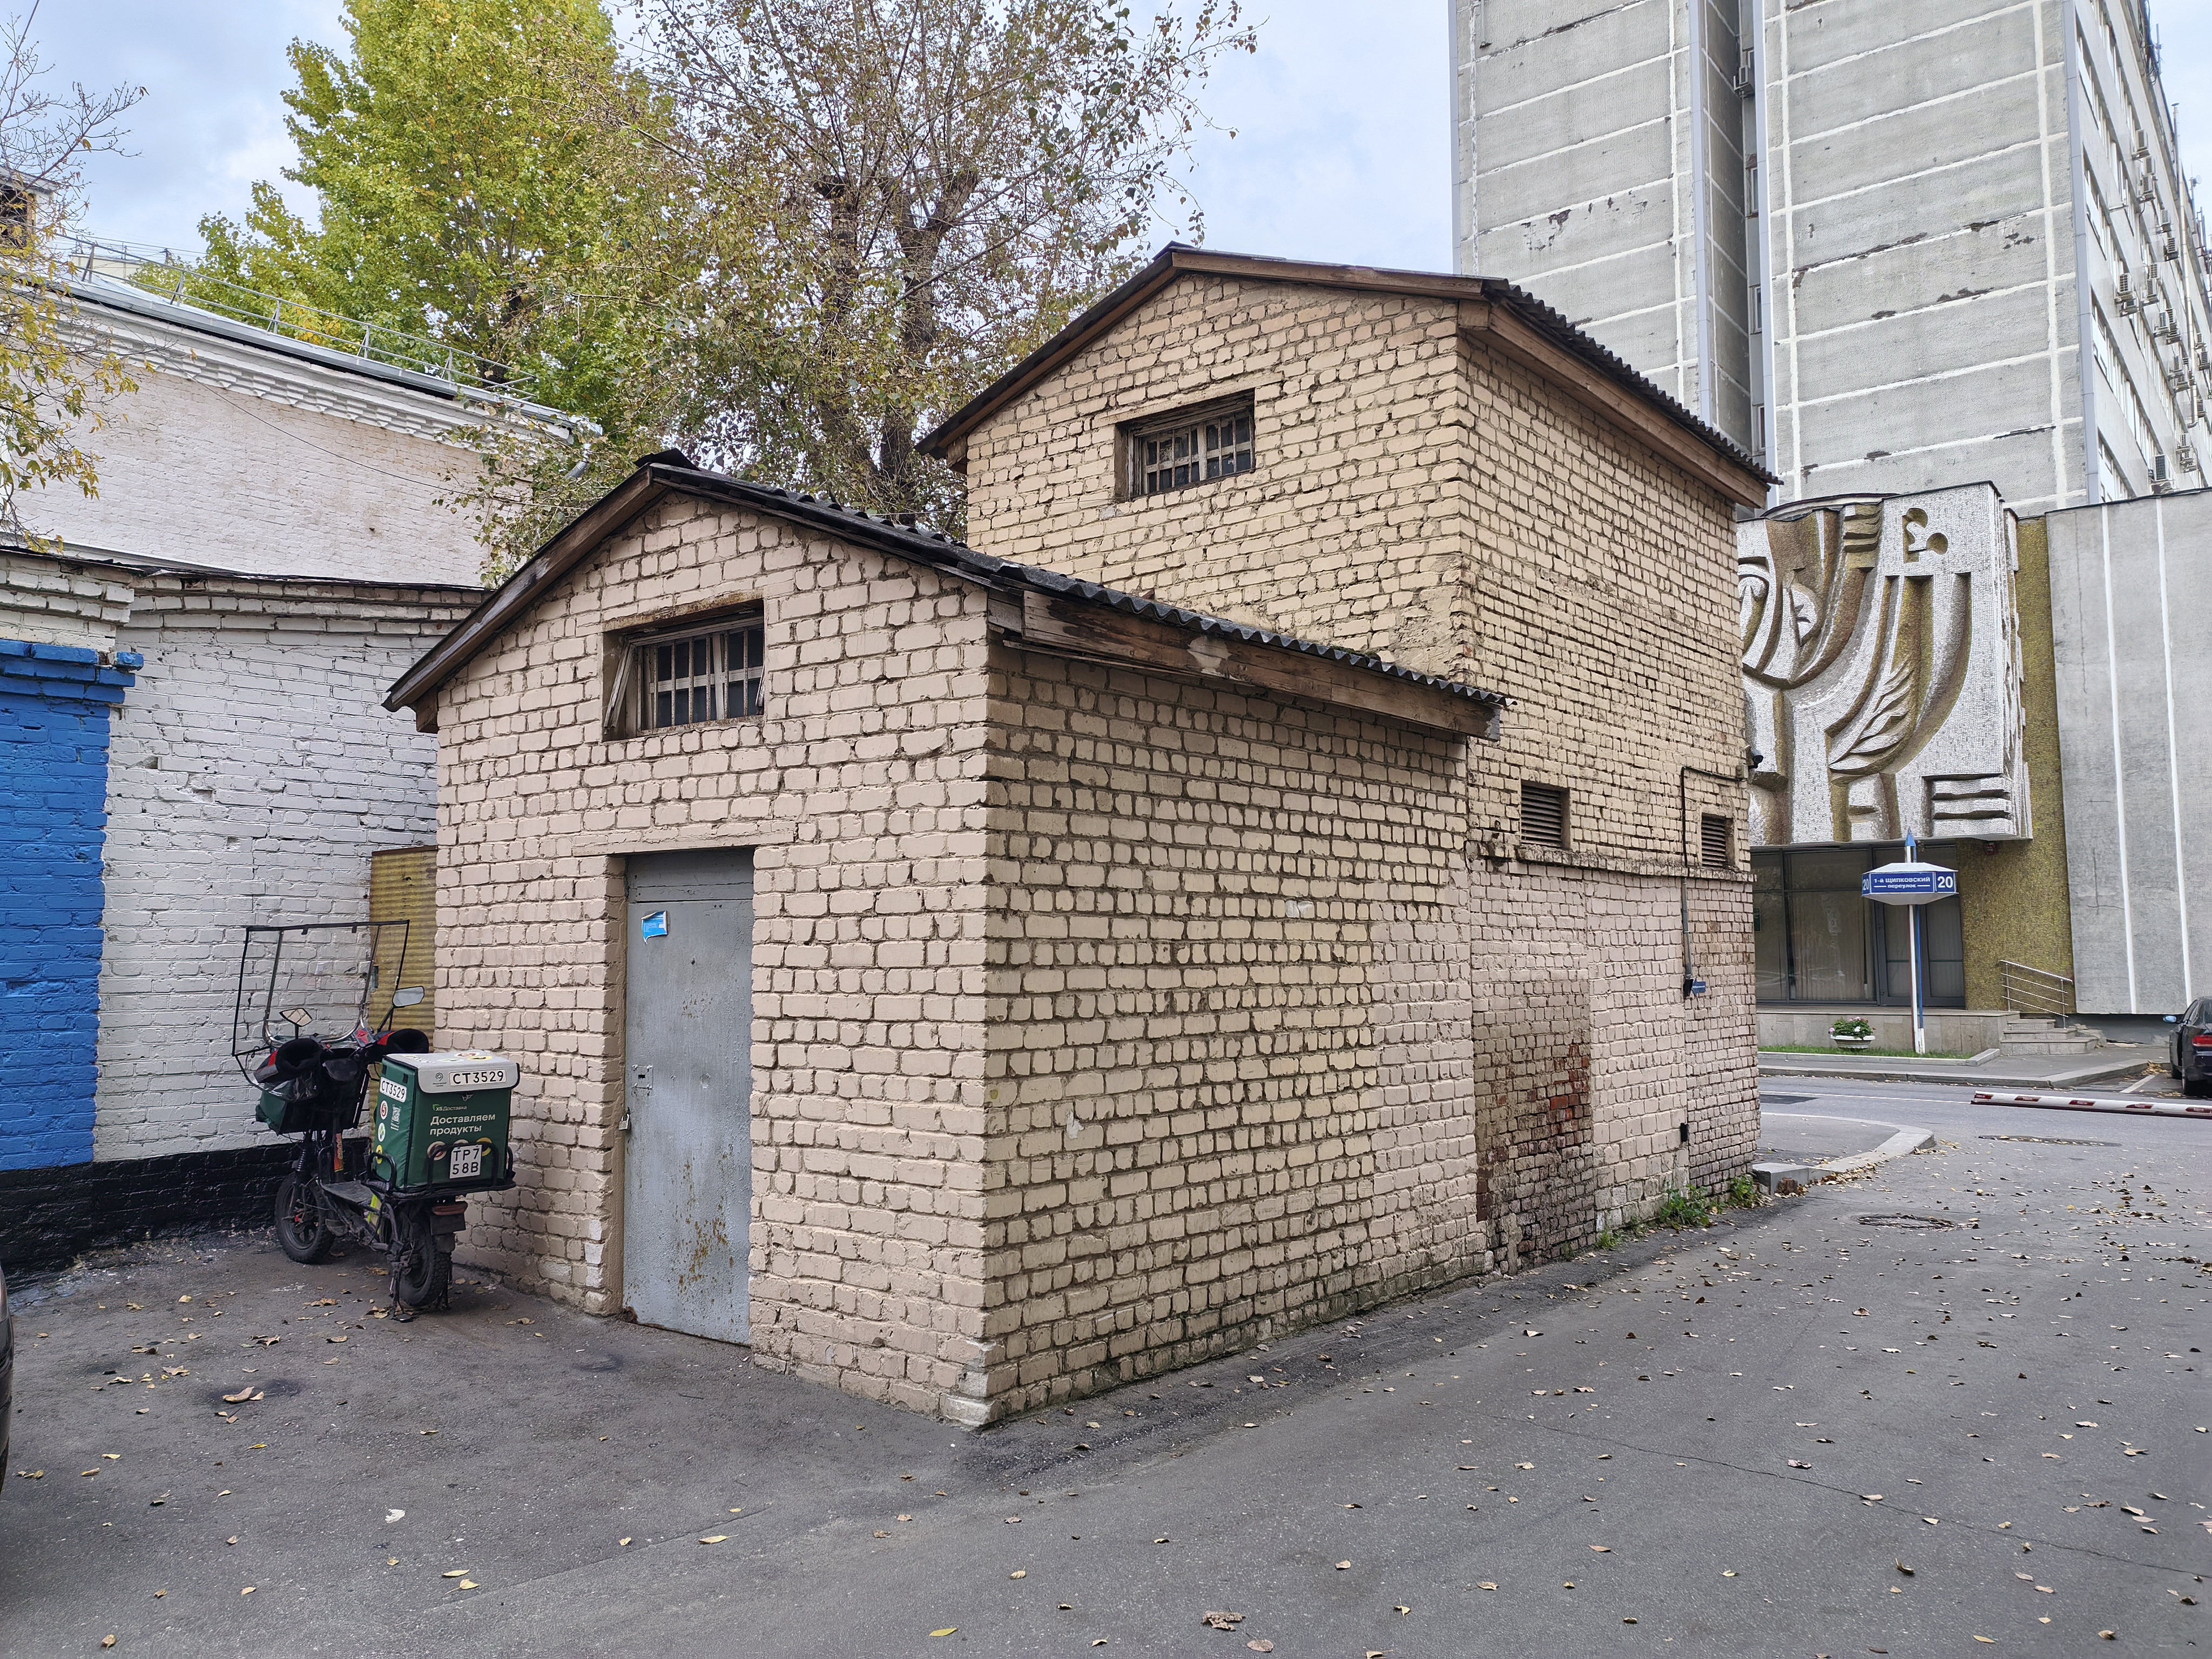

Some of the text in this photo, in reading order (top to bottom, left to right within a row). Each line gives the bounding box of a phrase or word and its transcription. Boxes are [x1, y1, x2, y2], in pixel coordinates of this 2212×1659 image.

[1863, 878, 1870, 891] 20
[1937, 876, 1953, 888] 20
[430, 1114, 496, 1126] Доставляем
[430, 1125, 482, 1137] продукты
